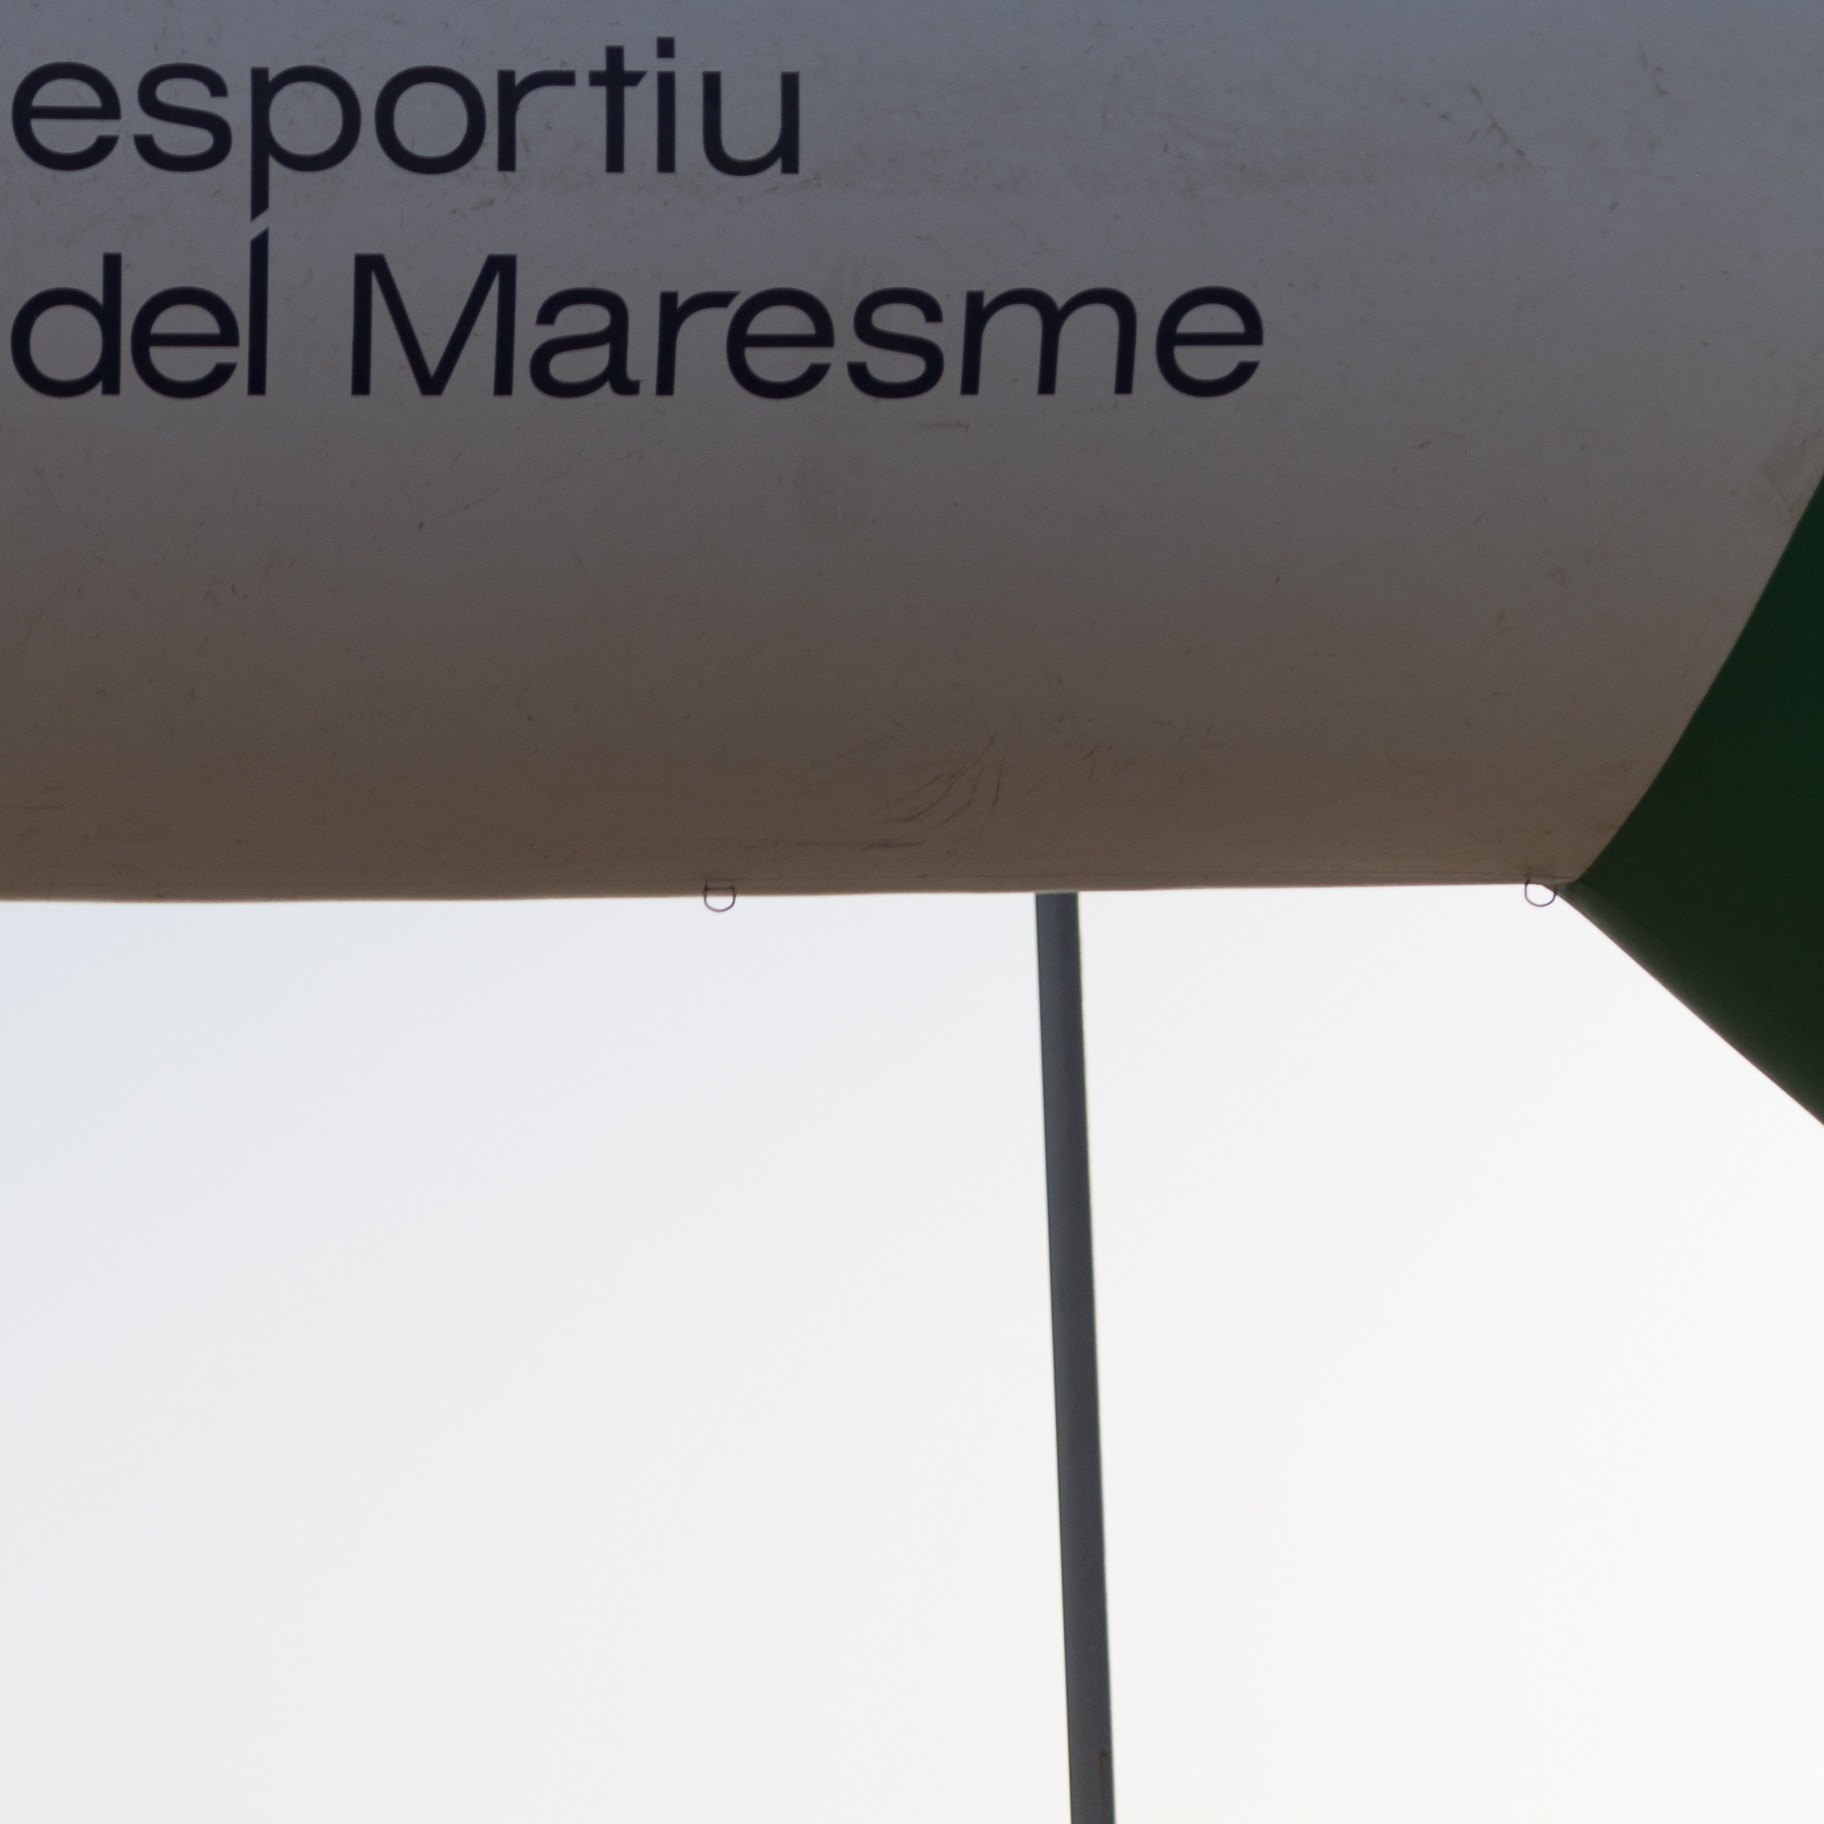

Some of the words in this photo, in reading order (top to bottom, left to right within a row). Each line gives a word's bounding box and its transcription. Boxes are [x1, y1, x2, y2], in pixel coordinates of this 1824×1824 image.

[11, 36, 802, 222] esportiu
[11, 227, 268, 400] del
[350, 252, 1264, 400] Maresme
